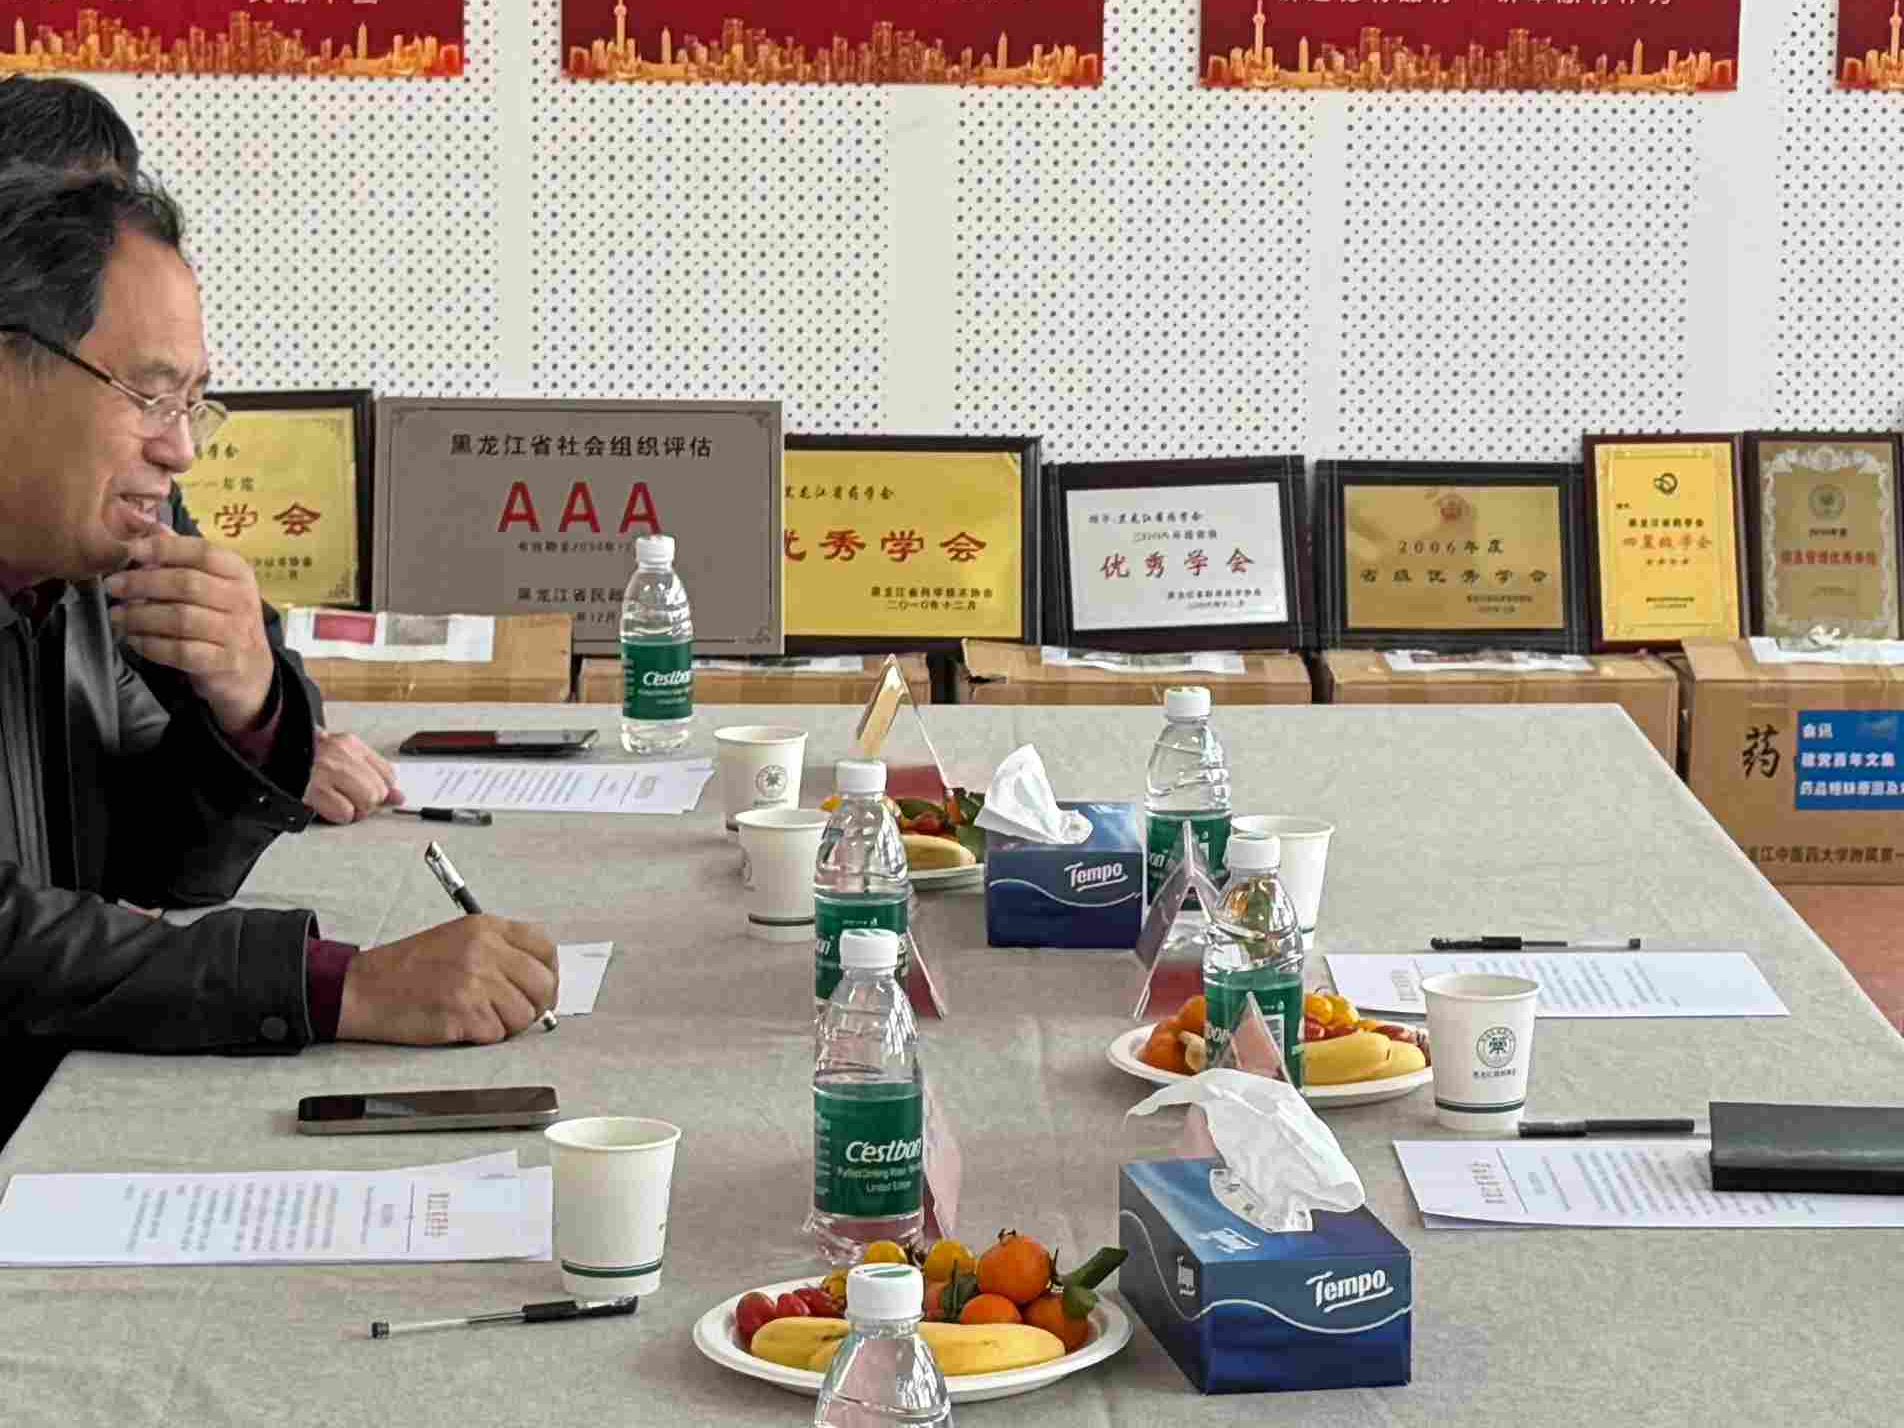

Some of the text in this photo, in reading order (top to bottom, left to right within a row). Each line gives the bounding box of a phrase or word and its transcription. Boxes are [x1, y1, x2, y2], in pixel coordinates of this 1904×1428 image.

[450, 432, 714, 459] 黑龙江省社会组织评估
[1099, 548, 1255, 580] 优秀学会
[1740, 723, 1782, 779] 药
[1064, 860, 1127, 889] Tempo
[1305, 1269, 1387, 1308] Tempo
